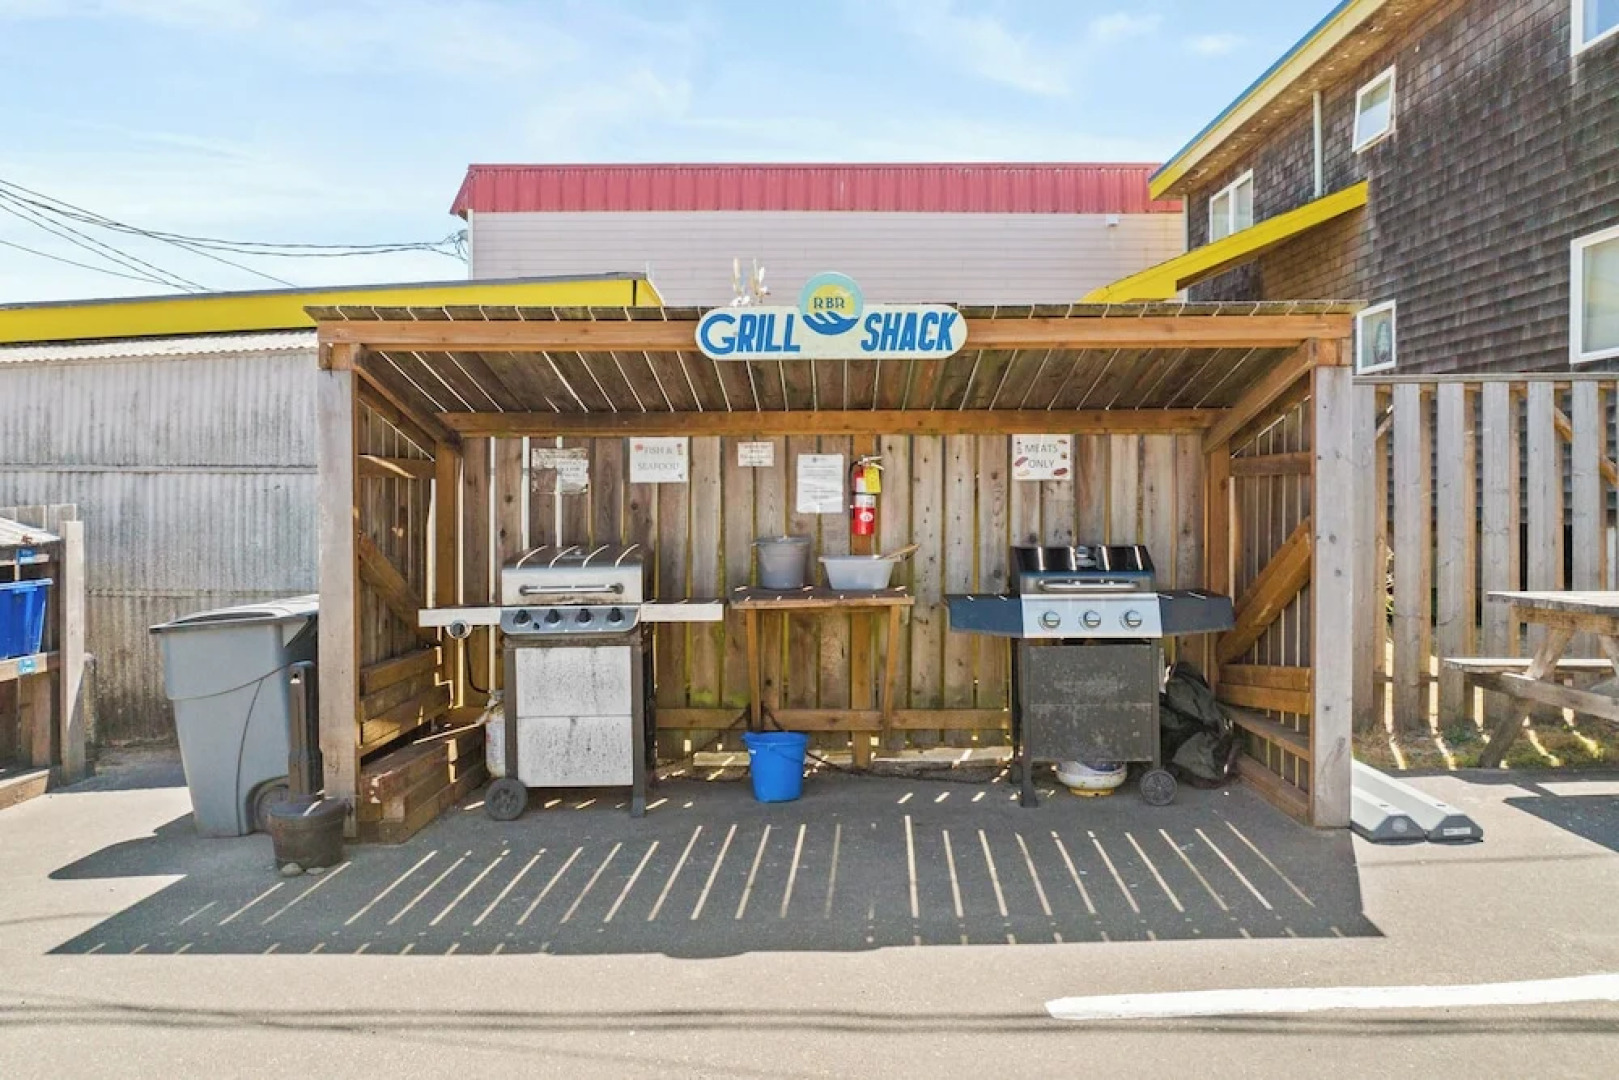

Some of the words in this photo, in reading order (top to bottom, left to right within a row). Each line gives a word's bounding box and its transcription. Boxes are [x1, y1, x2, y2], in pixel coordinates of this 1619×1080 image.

[813, 297, 845, 309] RBR
[700, 313, 801, 354] GRILL
[860, 312, 959, 352] SHACK
[644, 446, 664, 454] FISH
[666, 446, 673, 454] &
[1025, 444, 1058, 453] MEATS
[637, 462, 680, 471] SEAFOOD
[1028, 459, 1054, 469] ONLY
